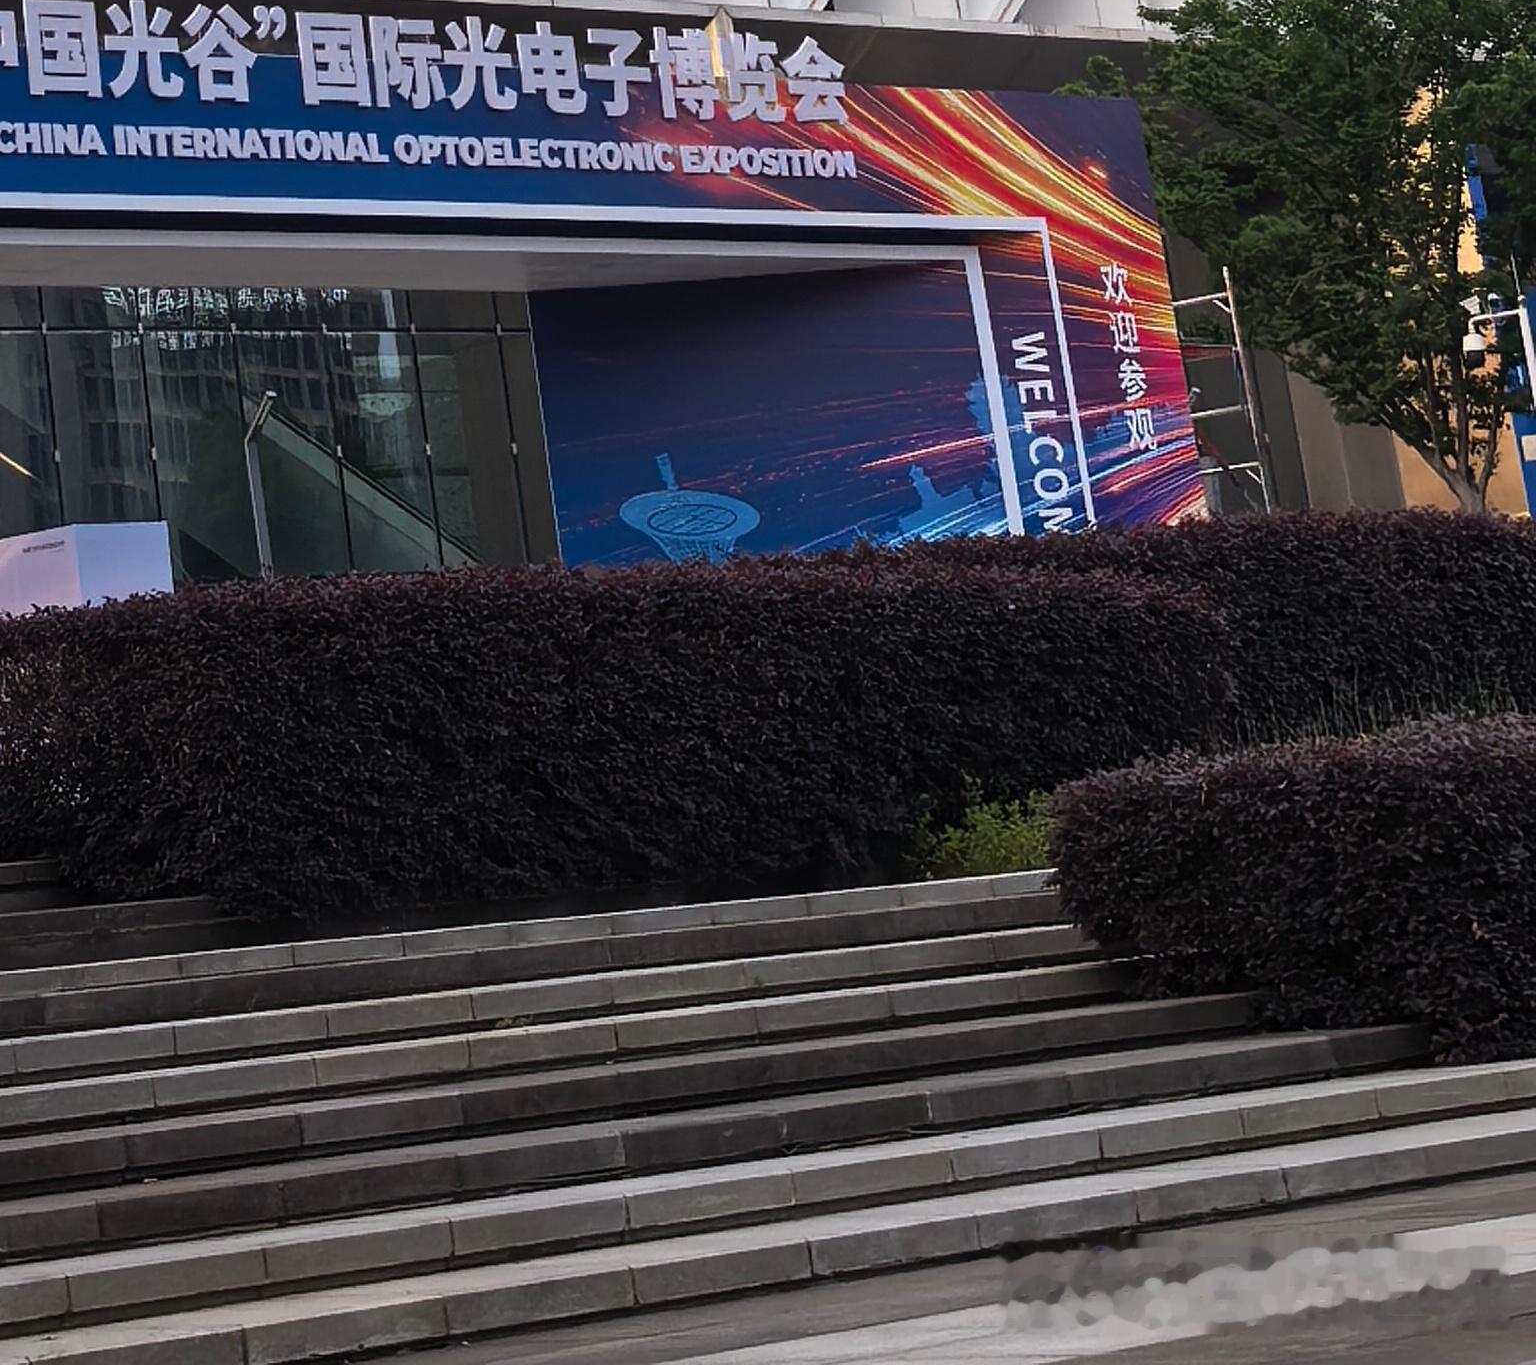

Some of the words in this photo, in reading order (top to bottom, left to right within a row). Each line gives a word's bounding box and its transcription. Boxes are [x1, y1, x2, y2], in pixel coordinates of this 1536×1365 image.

[113, 124, 390, 164] INTERNATIONAL
[394, 134, 674, 173] OPTOELECTRONIC
[680, 145, 857, 178] EXPOSITION
[1100, 261, 1158, 450] 欢迎参观
